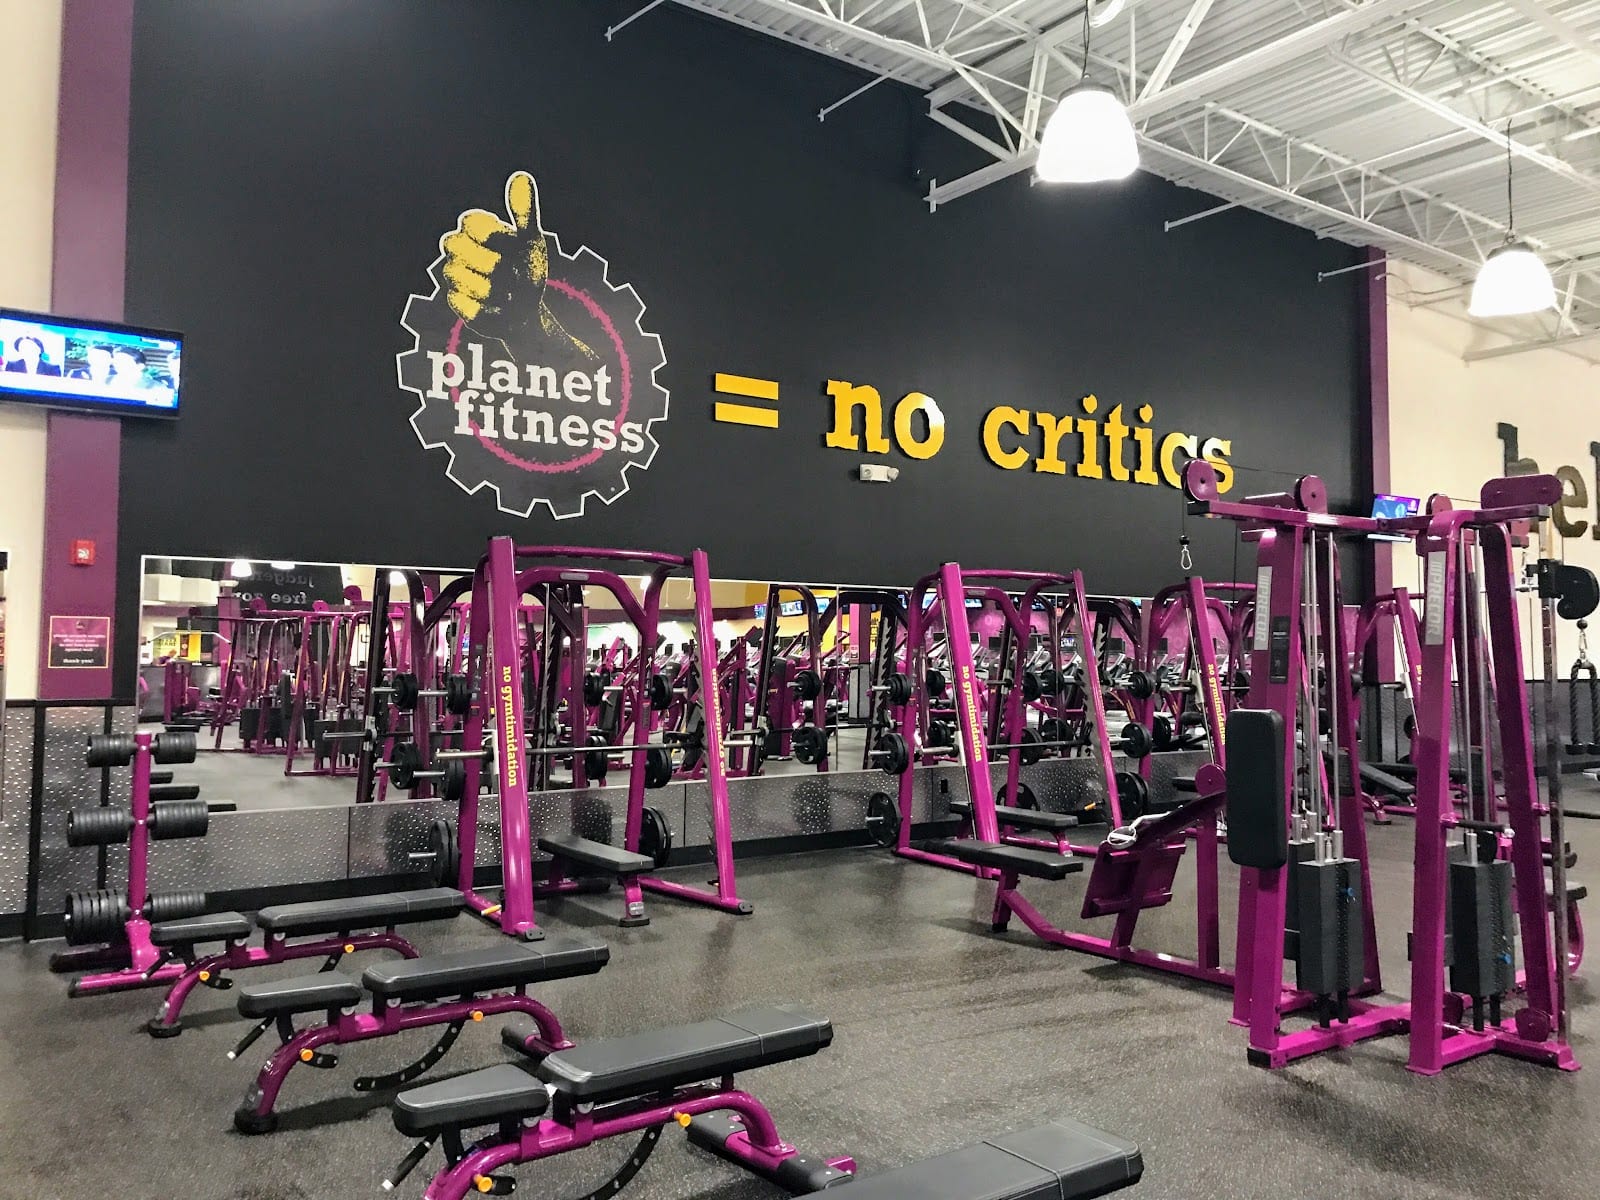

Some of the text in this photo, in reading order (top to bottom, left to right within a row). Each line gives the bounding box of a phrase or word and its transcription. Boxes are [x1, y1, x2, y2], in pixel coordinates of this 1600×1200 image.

[427, 343, 611, 406] planet
[454, 390, 645, 453] fitness
[827, 379, 945, 459] no
[983, 394, 1234, 494] critics
[1257, 584, 1270, 642] PRECOR
[1427, 571, 1443, 636] PRECOR
[1208, 664, 1215, 675] no
[501, 666, 519, 787] no gymtimidation
[962, 666, 982, 762] no gymtimidation
